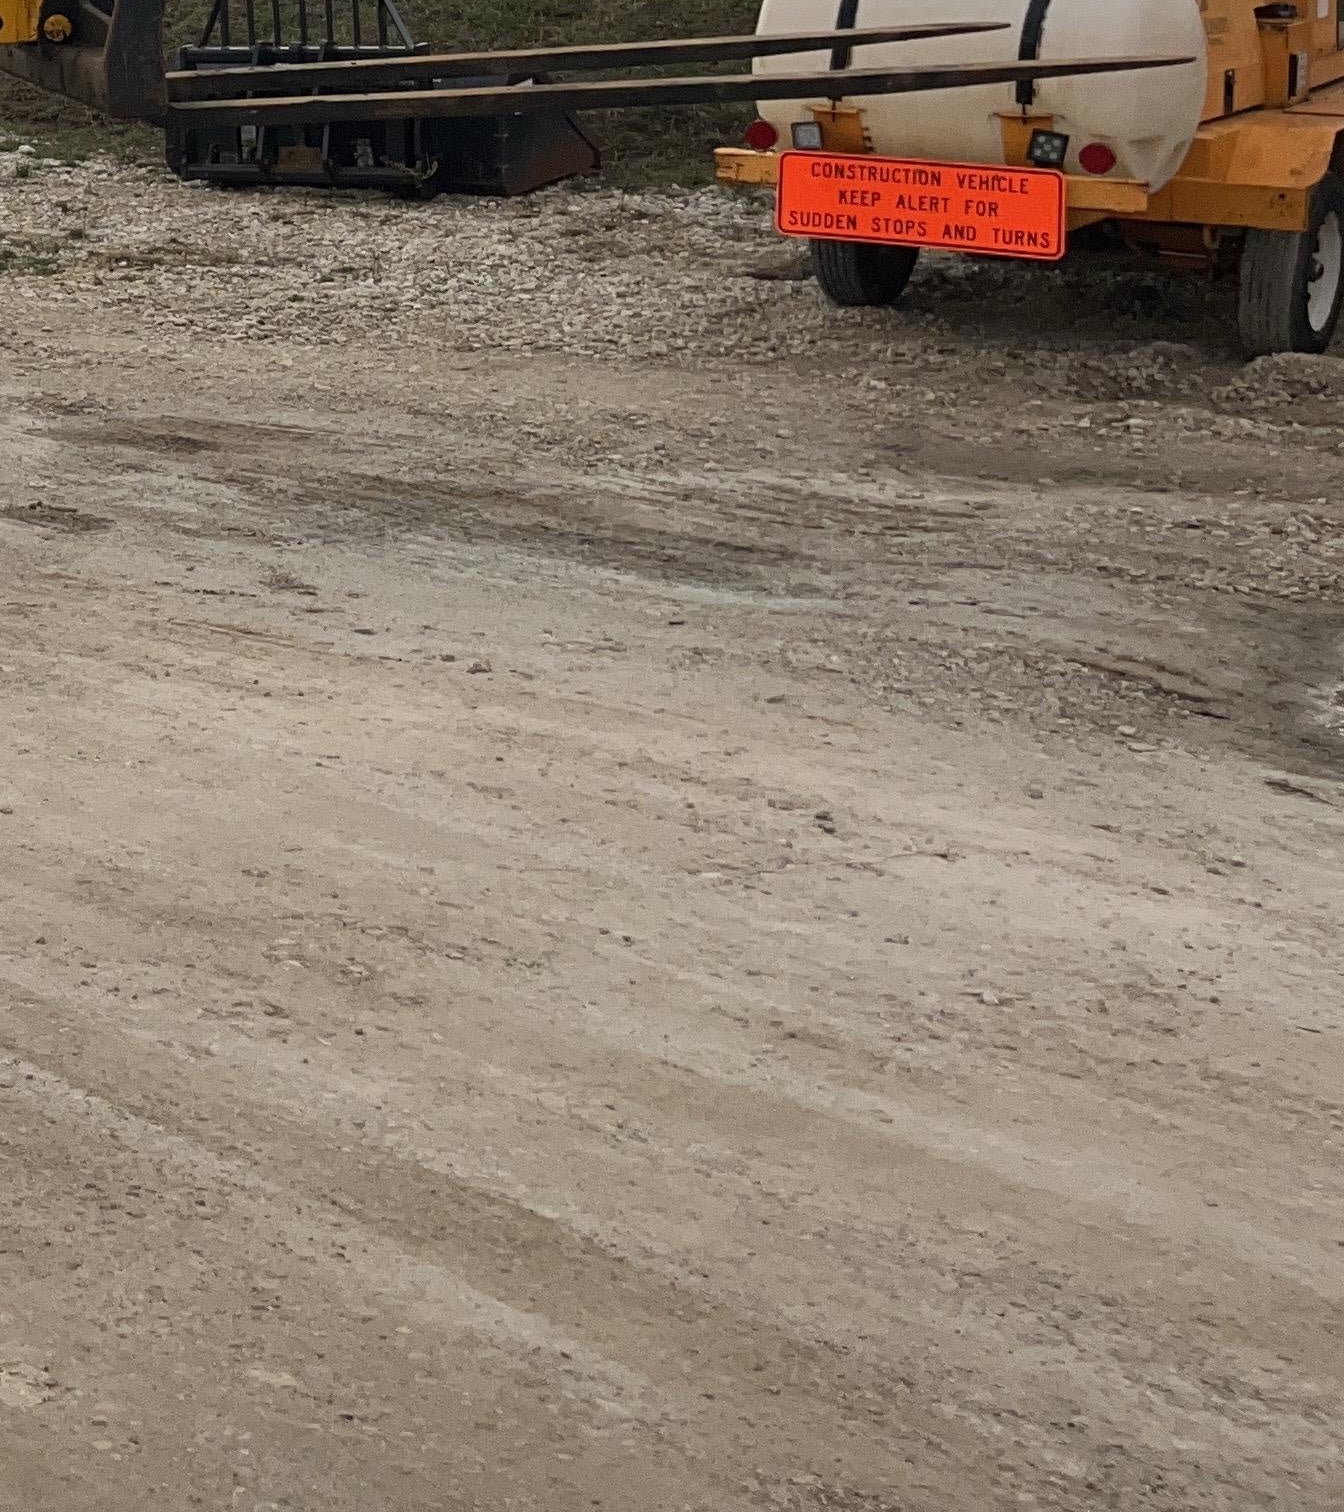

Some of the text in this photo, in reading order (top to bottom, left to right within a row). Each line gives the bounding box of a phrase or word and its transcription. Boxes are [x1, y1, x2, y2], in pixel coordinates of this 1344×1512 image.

[811, 161, 1030, 195] CONSTRUCTION VEHICLE
[838, 189, 999, 217] KEEP ALERT FOR
[788, 210, 1050, 250] SUDDEN STOPS AND TURNS
